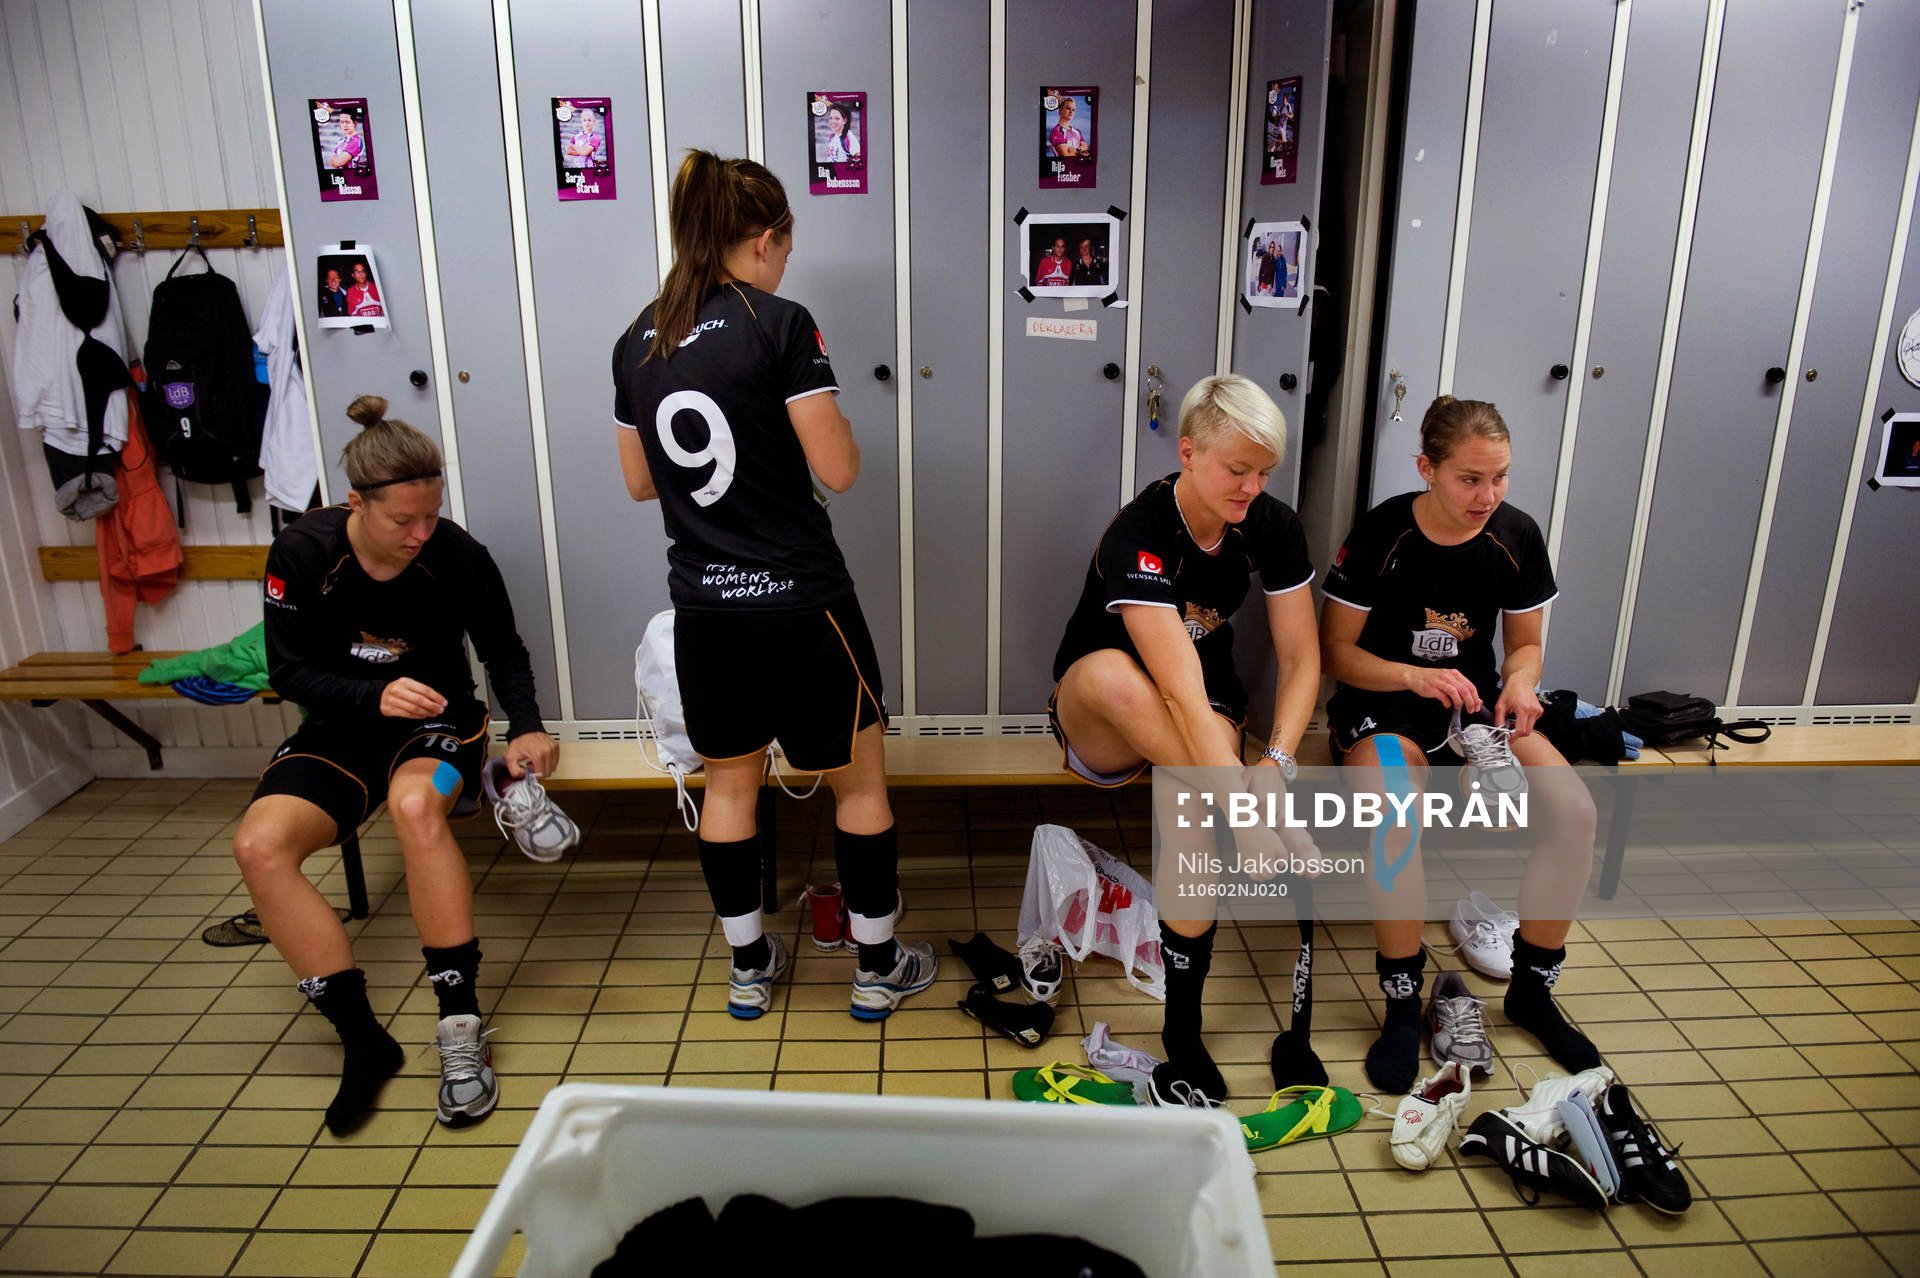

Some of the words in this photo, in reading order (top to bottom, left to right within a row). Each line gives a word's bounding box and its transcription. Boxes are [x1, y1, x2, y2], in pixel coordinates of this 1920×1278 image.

[1057, 170, 1080, 182] Fischer
[180, 416, 191, 438] 9
[655, 389, 737, 508] 9
[702, 571, 770, 586] WOMENS
[1126, 572, 1159, 581] SVENSKA
[721, 579, 794, 600] WORLD.SE
[1418, 634, 1455, 652] LdB
[1350, 716, 1377, 739] 14
[424, 734, 460, 753] 16
